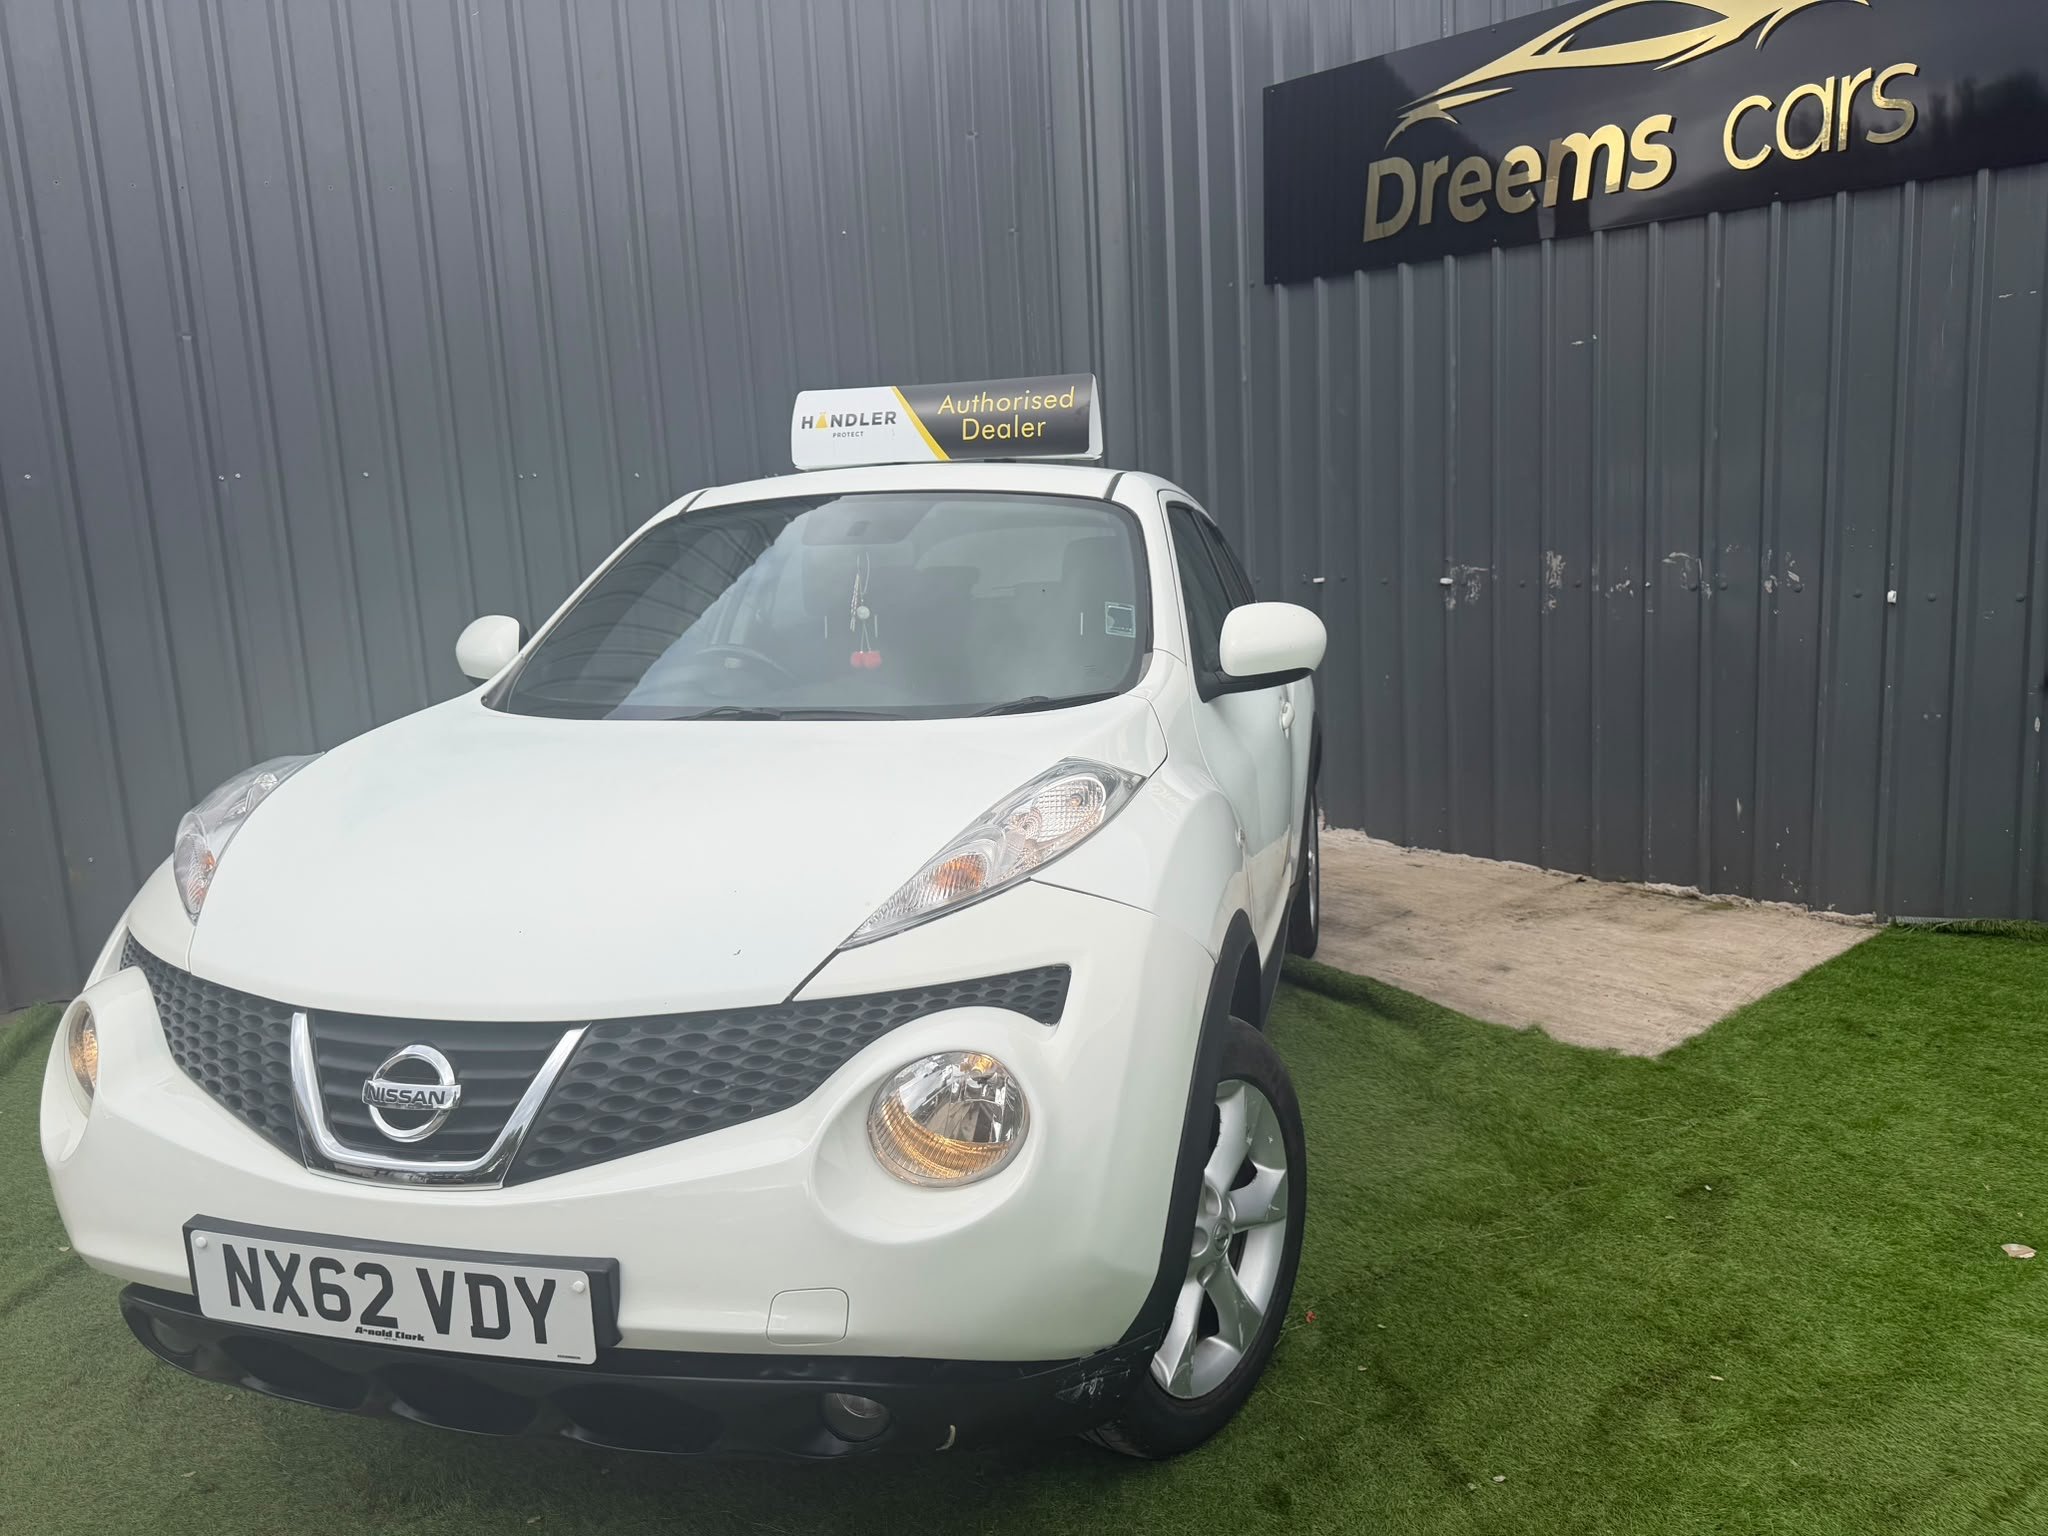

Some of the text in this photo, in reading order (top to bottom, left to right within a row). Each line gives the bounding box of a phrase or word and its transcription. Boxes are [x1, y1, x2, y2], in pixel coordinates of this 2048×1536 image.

[1362, 62, 1919, 243] Dreems cars
[937, 386, 1075, 415] Authorised
[961, 415, 1047, 441] Dealer
[366, 1085, 446, 1105] NISSAN
[222, 1243, 557, 1344] NX62 VDY
